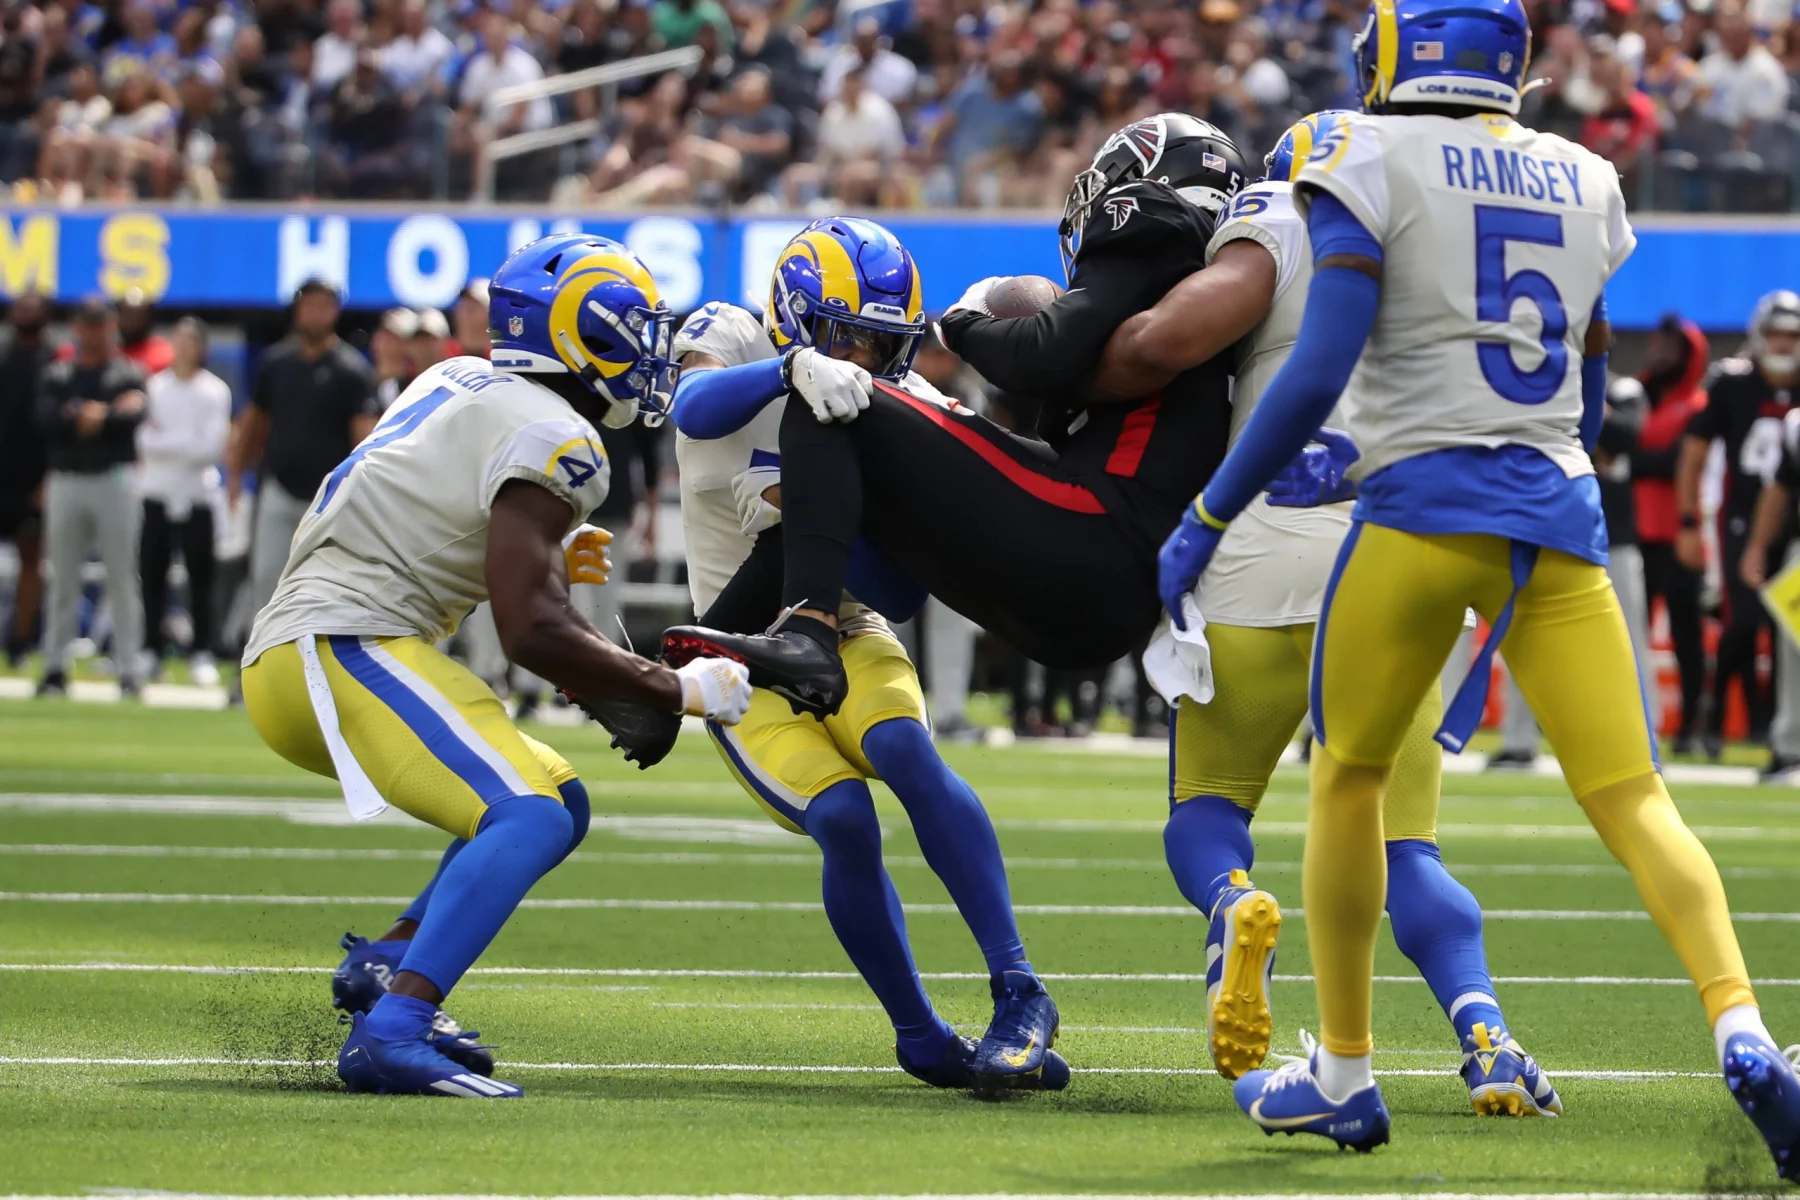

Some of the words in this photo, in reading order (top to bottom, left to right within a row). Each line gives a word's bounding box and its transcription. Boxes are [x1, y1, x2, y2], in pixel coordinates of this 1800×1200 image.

[1418, 85, 1448, 94] LOS
[1442, 144, 1583, 206] RAMSEY
[1474, 203, 1568, 405] 5
[681, 317, 716, 340] 4
[315, 385, 456, 515] 4
[557, 455, 598, 489] 4
